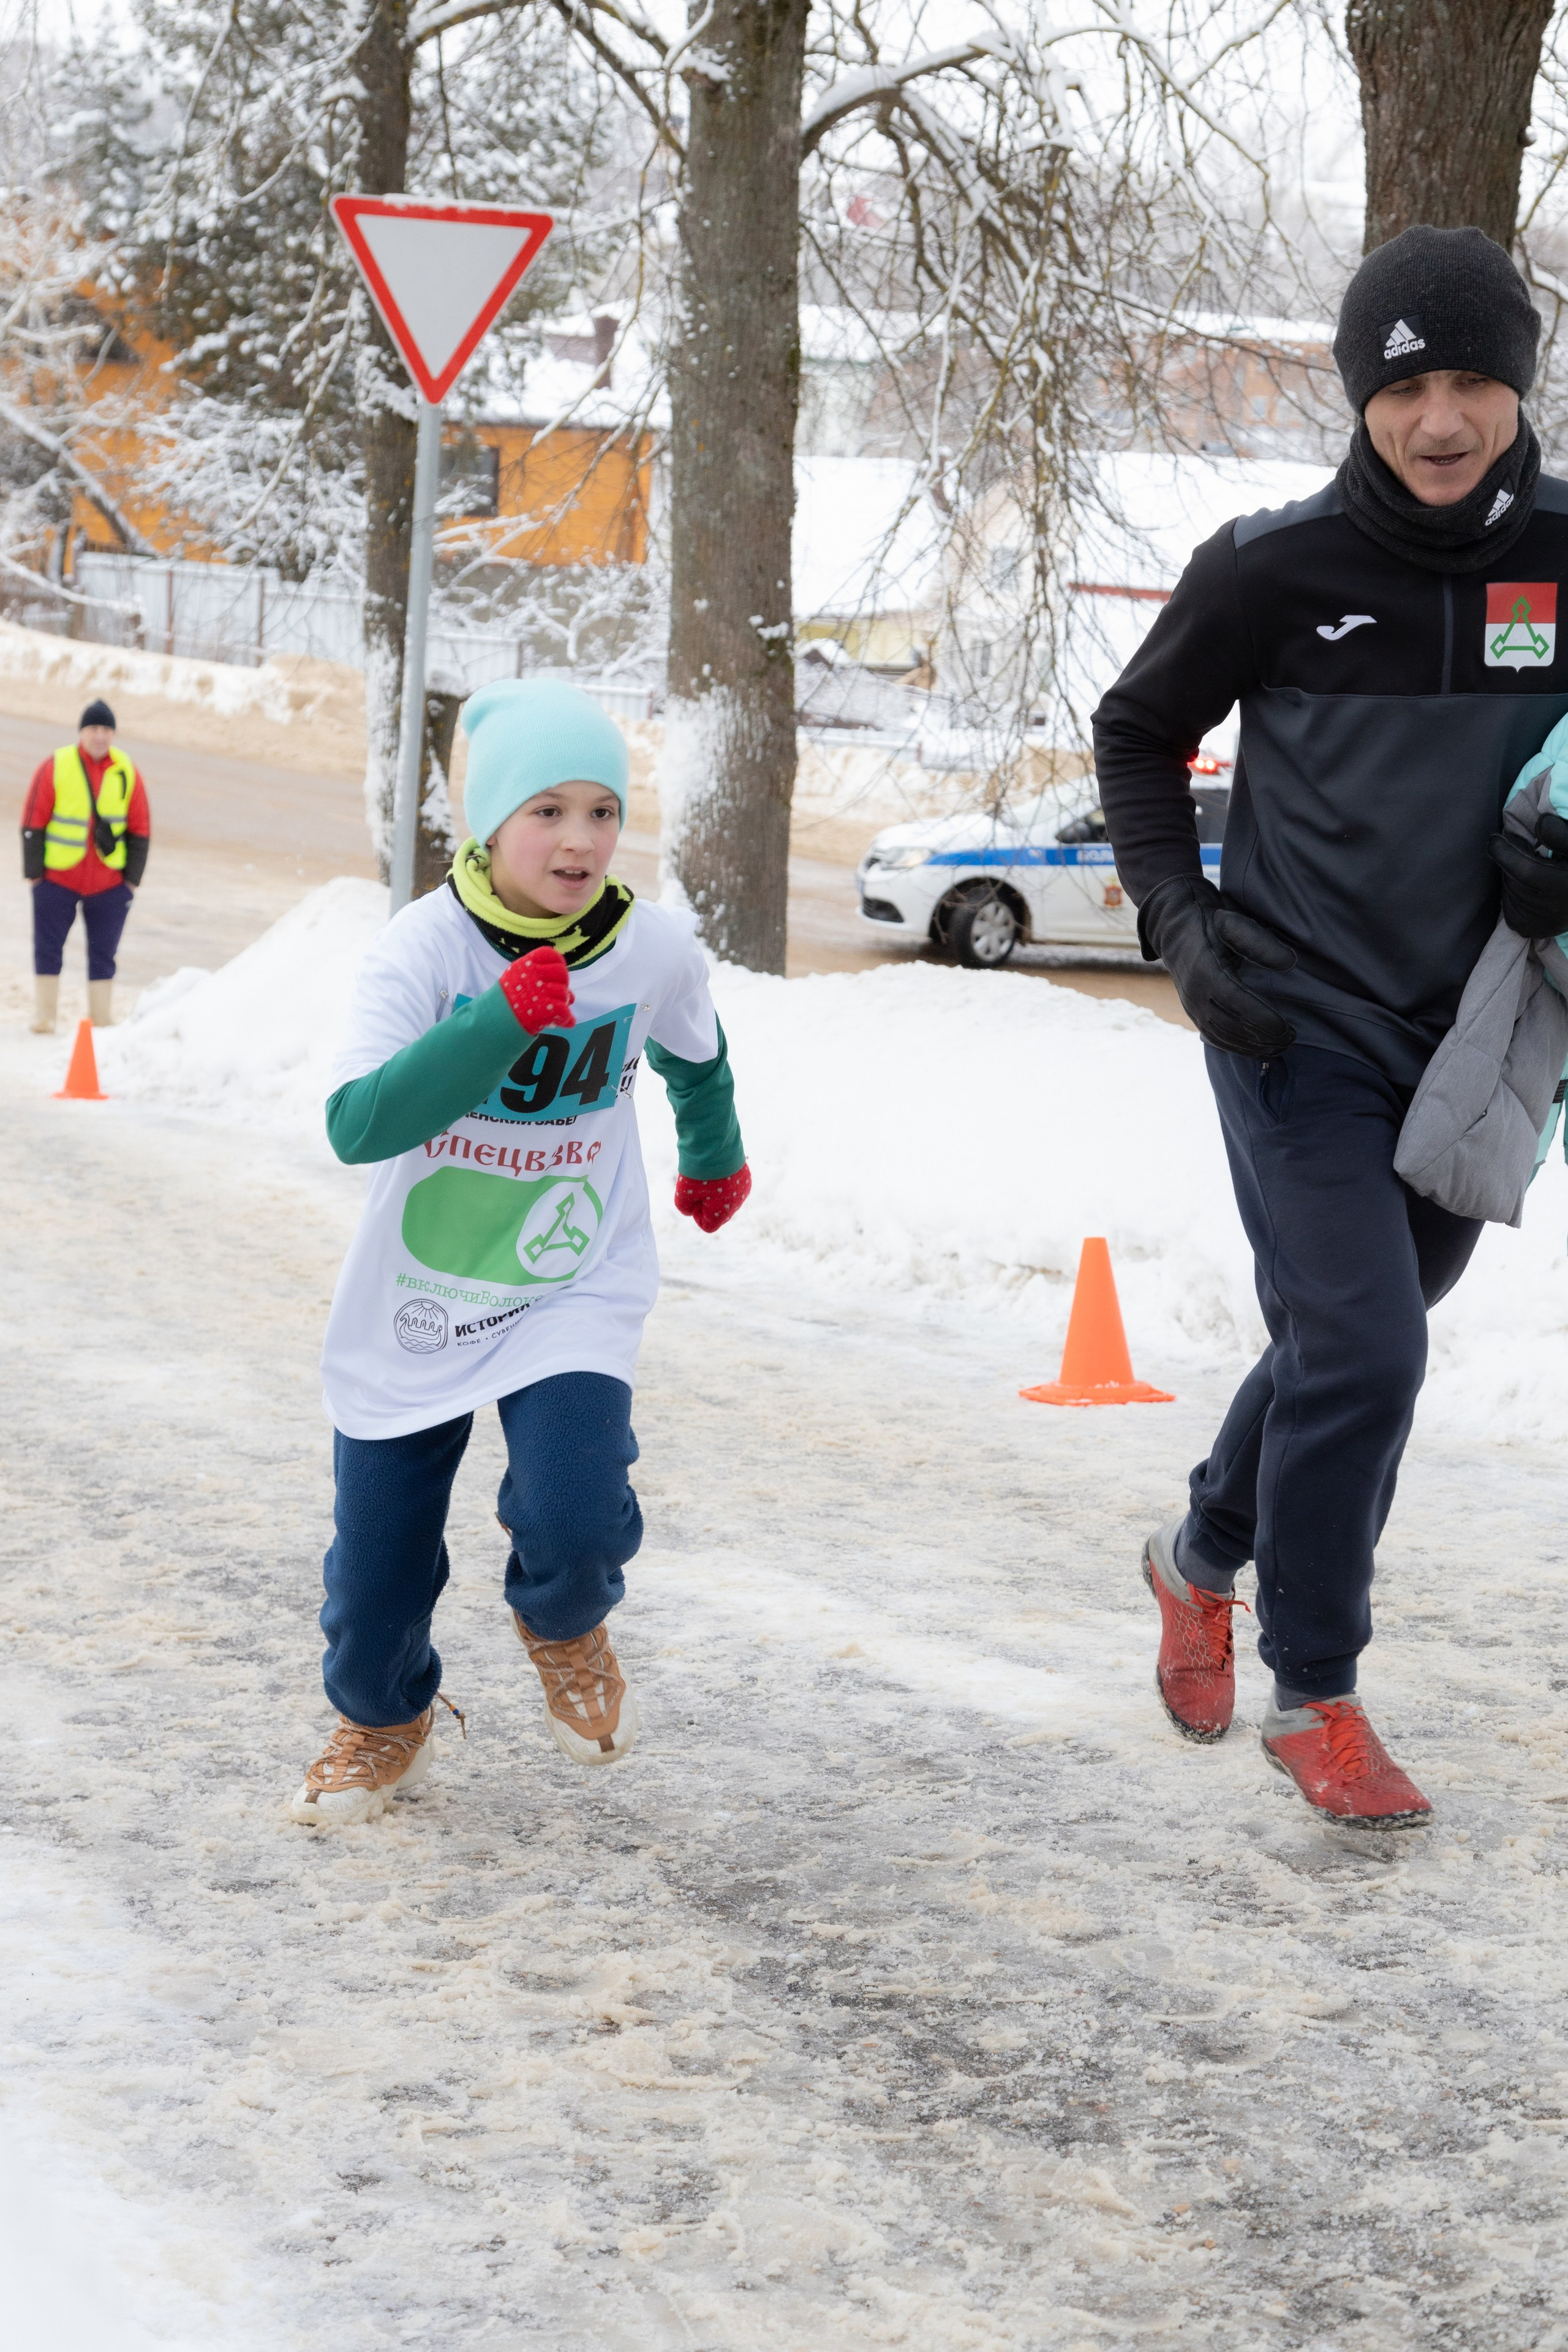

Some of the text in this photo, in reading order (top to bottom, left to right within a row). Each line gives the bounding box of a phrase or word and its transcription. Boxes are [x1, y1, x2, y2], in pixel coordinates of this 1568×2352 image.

[1384, 339, 1426, 360] adidas
[1485, 494, 1514, 526] adidas
[483, 1020, 617, 1113] 94
[457, 1338, 481, 1347] КОФЕ
